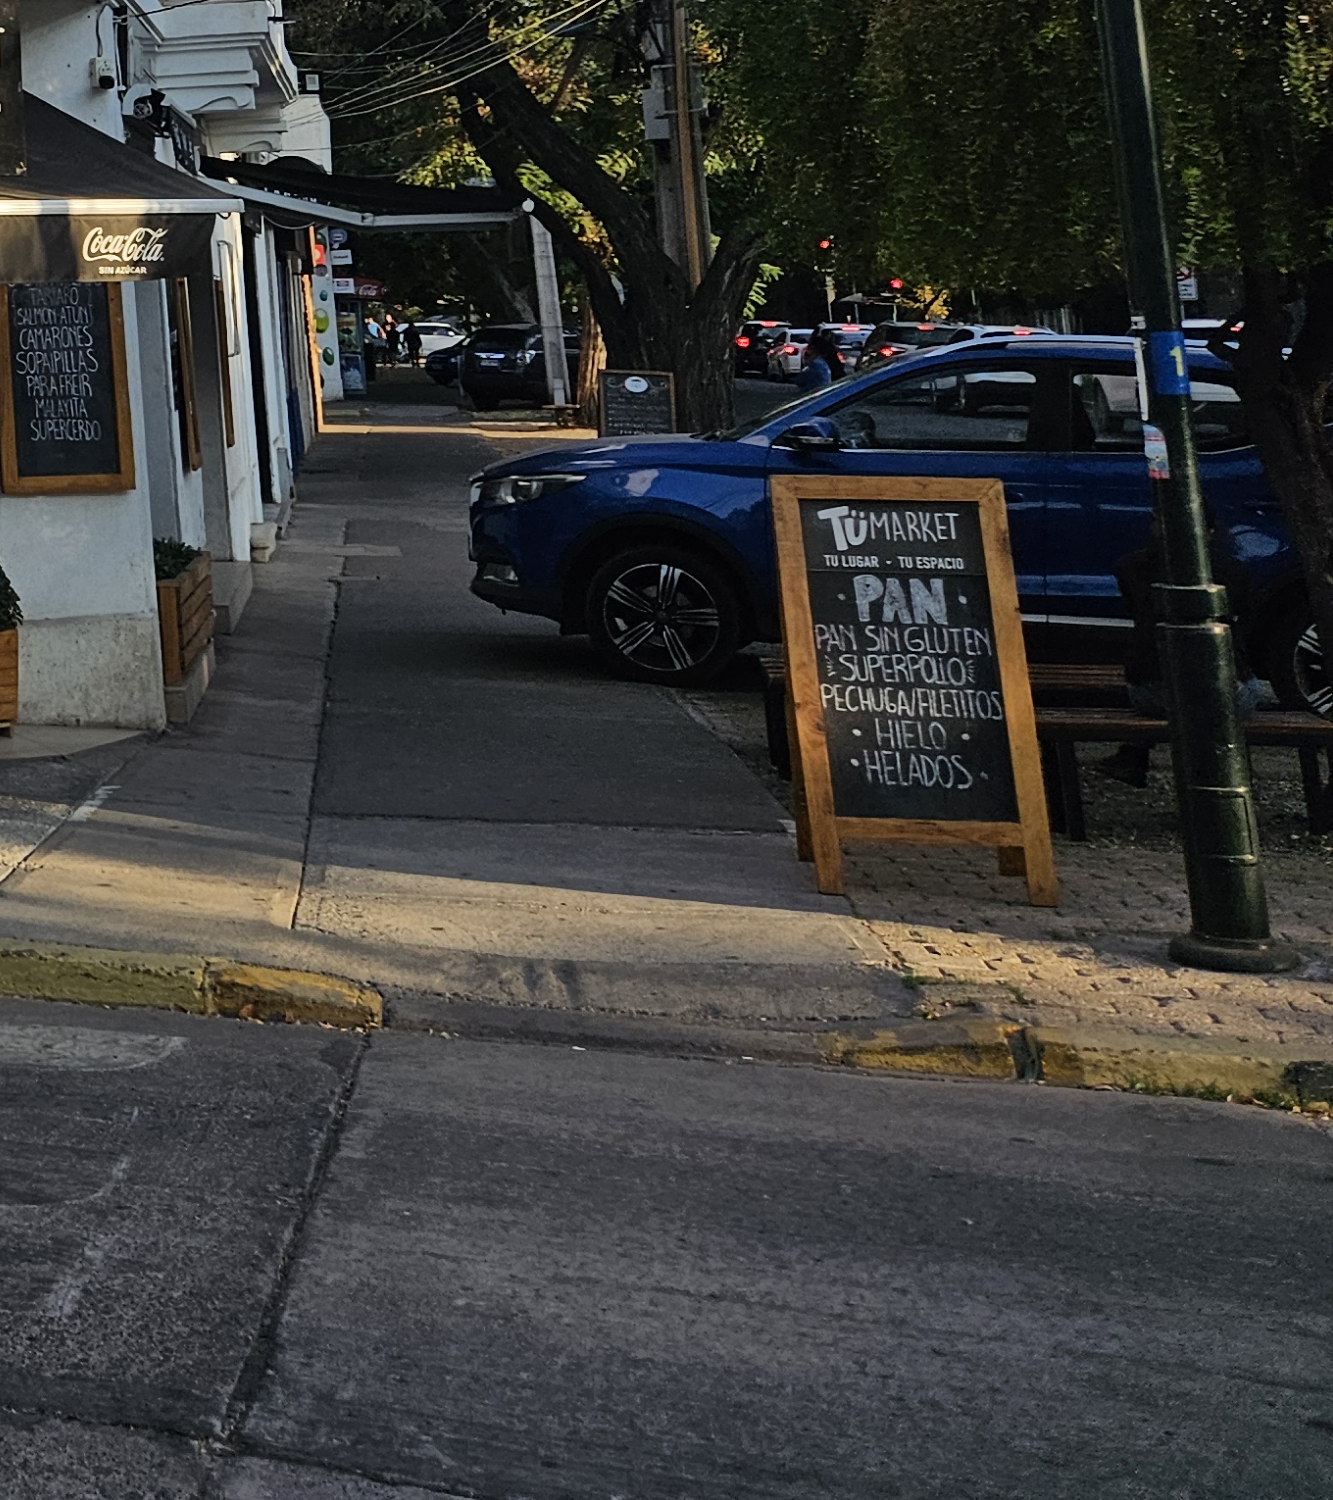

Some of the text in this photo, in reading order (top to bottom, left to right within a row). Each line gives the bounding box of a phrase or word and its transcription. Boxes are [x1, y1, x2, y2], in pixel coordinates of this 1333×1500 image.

[82, 227, 169, 262] Coca-Cola
[98, 264, 148, 275] SIN AZÚCAR
[19, 325, 93, 350] CAMARONES
[15, 349, 99, 375] SOPAIPILLAS
[26, 375, 59, 397] PARA
[30, 419, 102, 441] SUPERCERDO
[823, 554, 965, 570] TU LUGAR TU ESPACIO
[852, 574, 949, 626] PAN
[814, 623, 992, 656] PAN SIN GLUTEN
[874, 717, 948, 750] HIELO
[863, 749, 974, 790] HELADOS
